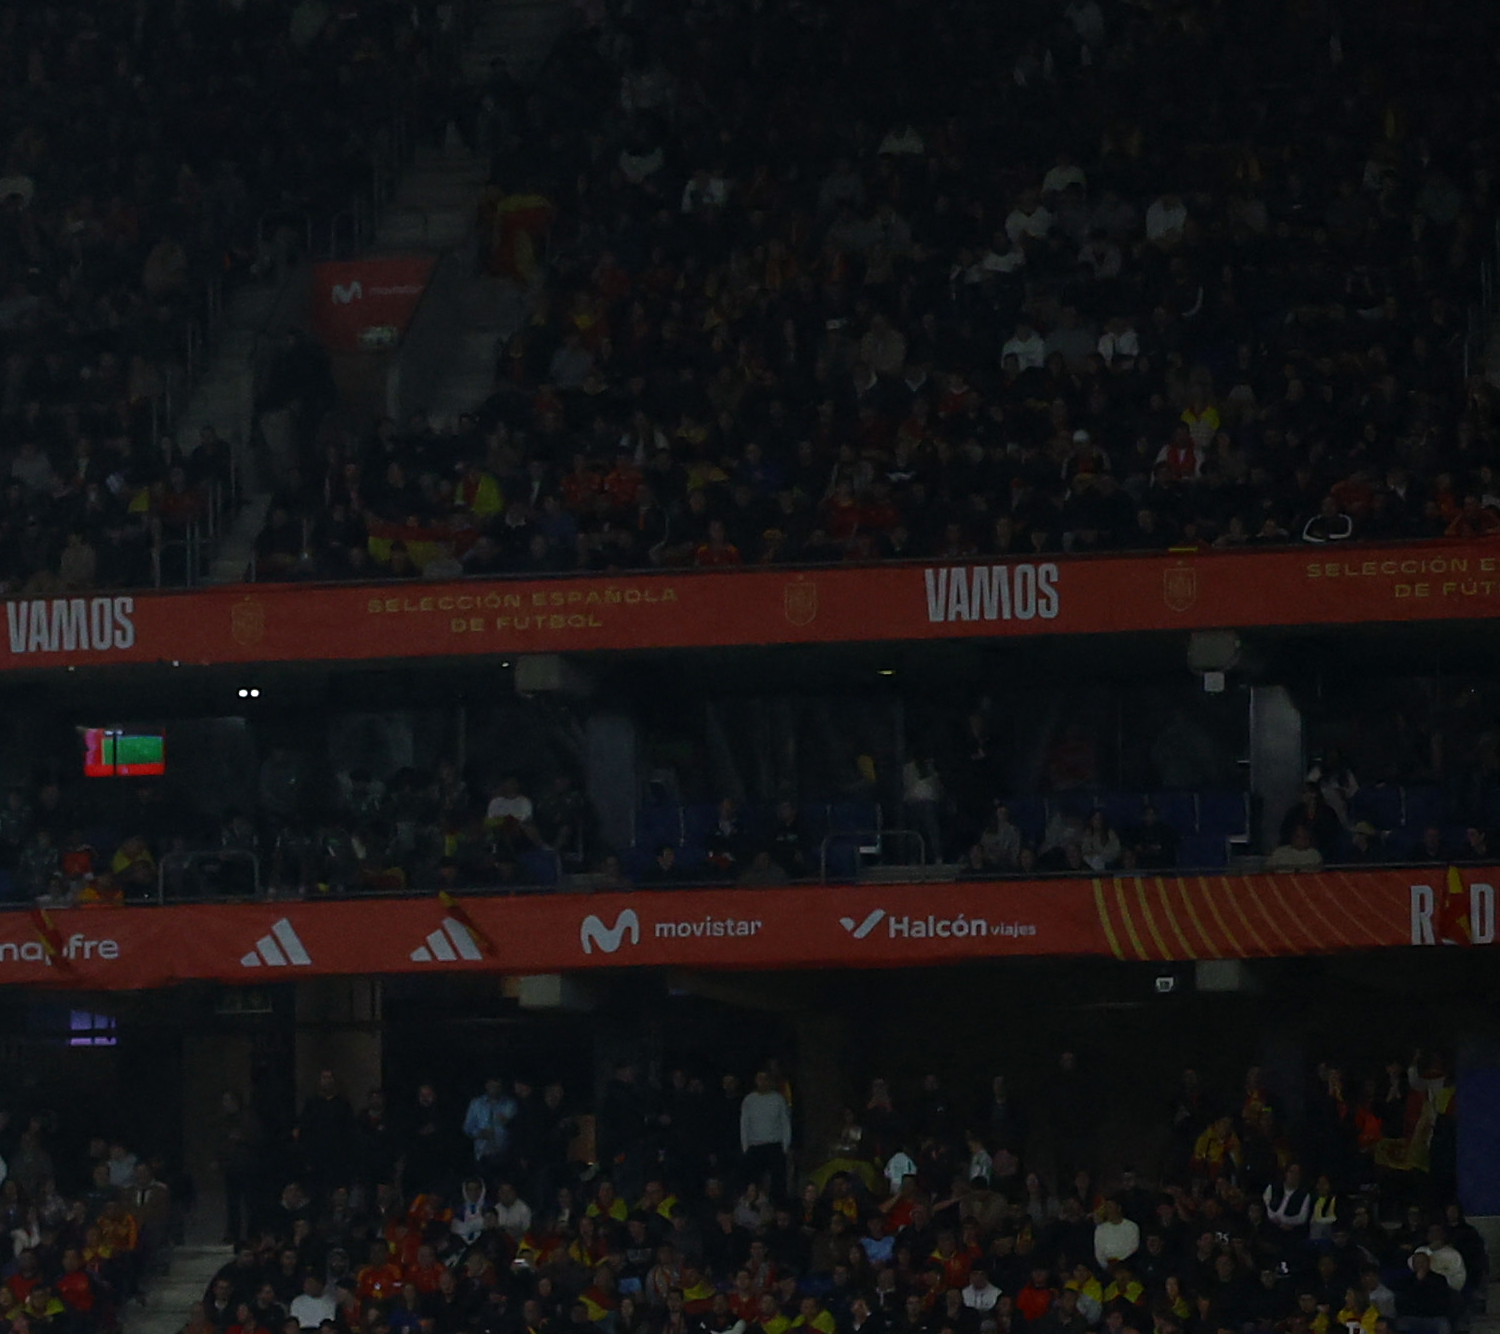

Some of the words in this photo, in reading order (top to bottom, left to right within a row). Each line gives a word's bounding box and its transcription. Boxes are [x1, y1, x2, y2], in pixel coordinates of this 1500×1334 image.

[1306, 555, 1468, 578] SELECCIÓN
[924, 563, 1060, 622] VAMOS
[1394, 582, 1430, 598] DE
[5, 597, 135, 654] VAMOS
[451, 618, 484, 632] DE
[654, 916, 763, 938] movistar
[888, 913, 988, 938] Halcón
[990, 922, 1036, 938] viajes
